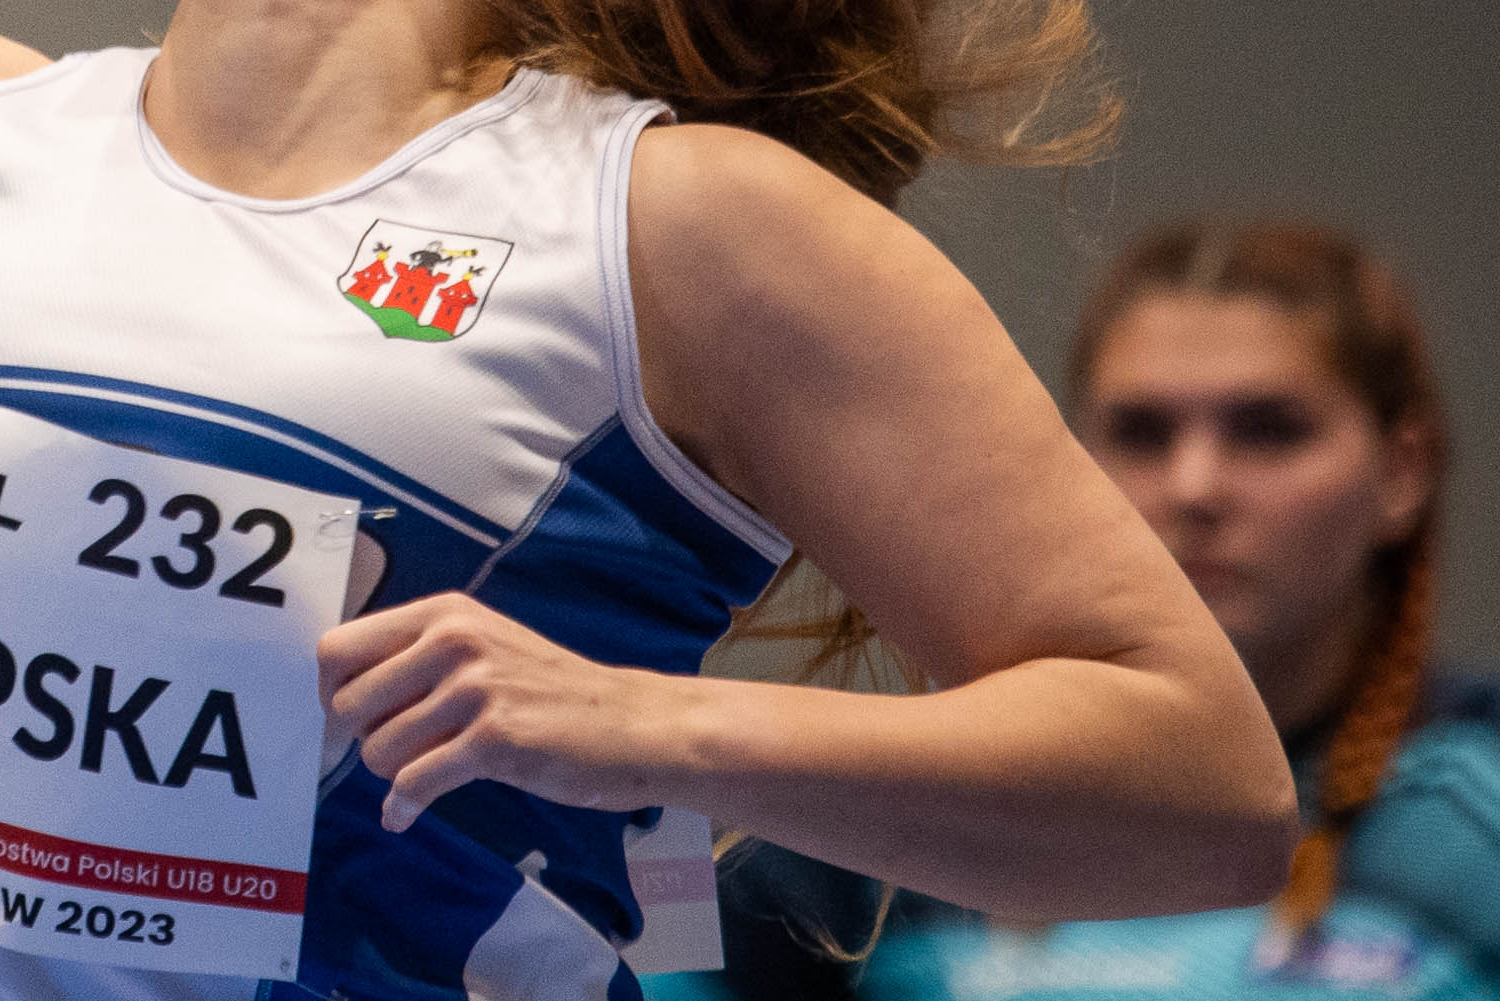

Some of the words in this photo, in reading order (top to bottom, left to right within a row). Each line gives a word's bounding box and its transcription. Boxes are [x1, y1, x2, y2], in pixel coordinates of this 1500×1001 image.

[78, 478, 294, 608] 232
[78, 855, 159, 886] Polski
[167, 868, 215, 893] U18
[223, 876, 278, 900] U20
[54, 901, 176, 946] 2023
